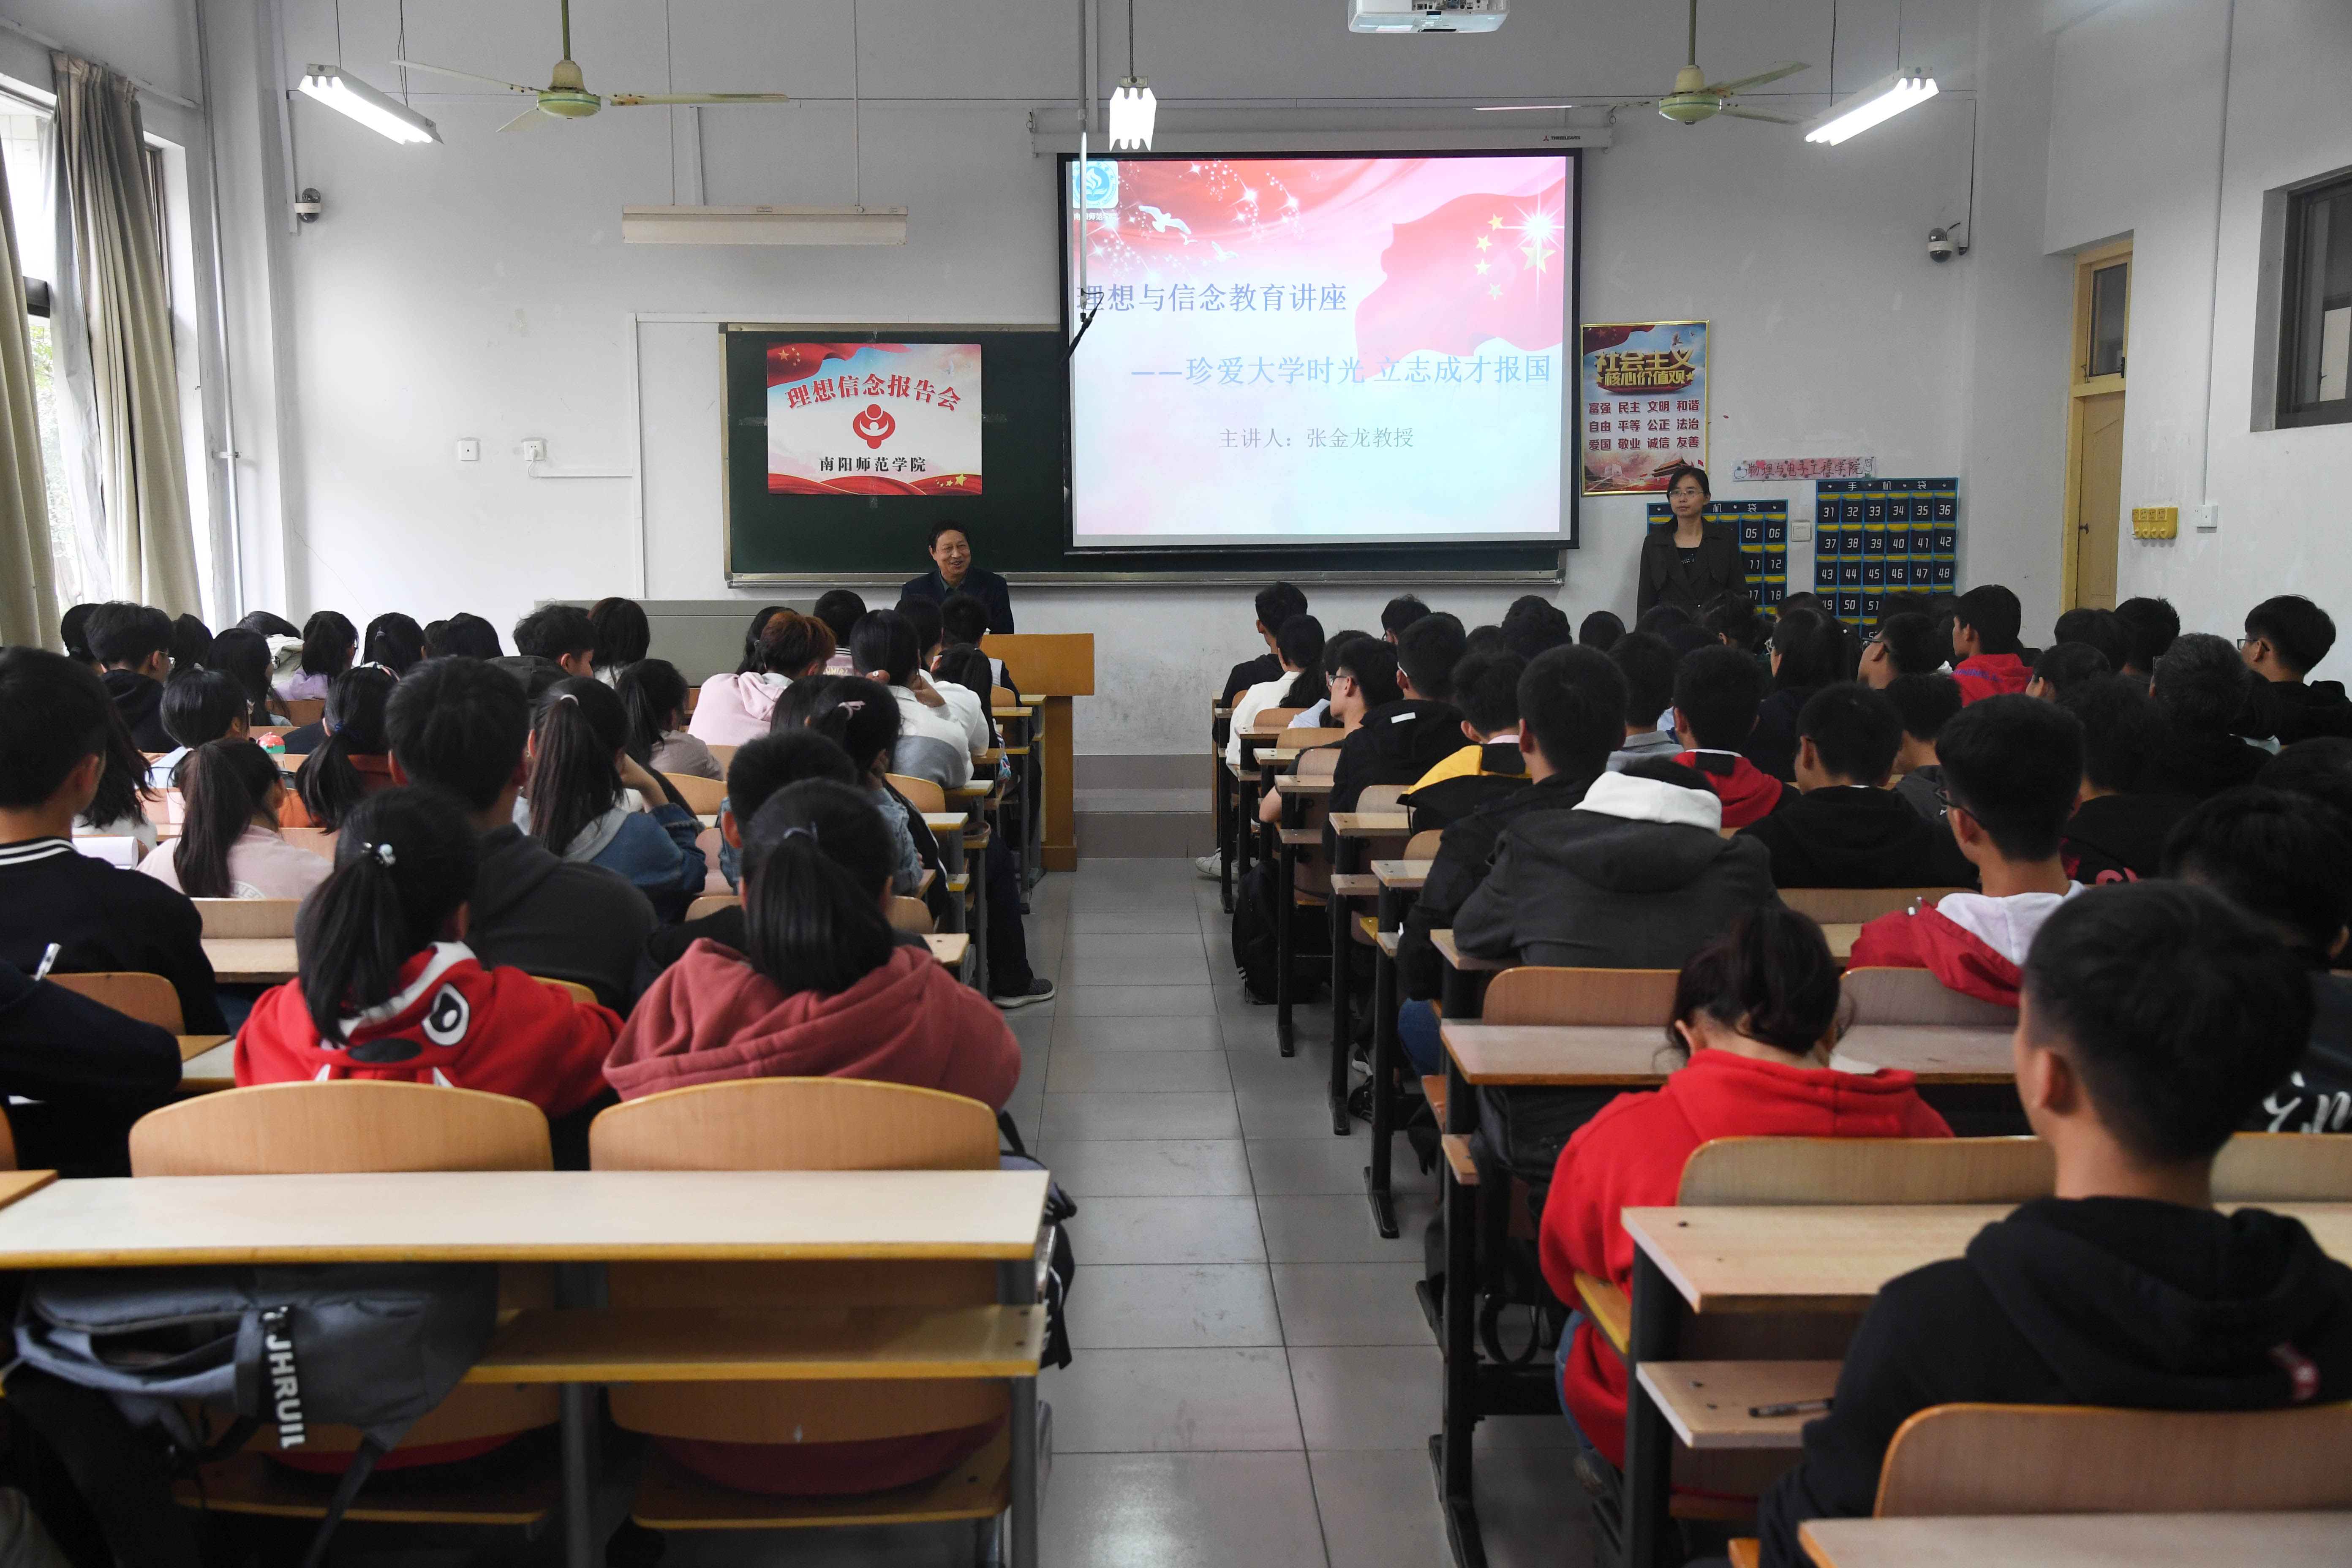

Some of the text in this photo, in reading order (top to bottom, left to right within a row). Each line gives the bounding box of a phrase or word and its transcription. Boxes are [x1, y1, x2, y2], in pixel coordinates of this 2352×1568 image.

[1076, 284, 1347, 312] 理想与信念教育讲座
[1594, 348, 1695, 372] 社会主义
[1374, 355, 1551, 384] 立志成才报国
[1604, 370, 1685, 386] 核心价值观
[785, 373, 961, 411] 理想信念报告会
[1589, 400, 1699, 414] 富强 民主 文明 和谐
[1589, 418, 1699, 432] 自由 平等 公正 法治
[1589, 436, 1699, 450] 爱国 敬业 诚信 友善
[819, 457, 926, 472] 南阳师范学院
[1748, 460, 1863, 477] 物理与电子工程学院
[1824, 504, 1951, 517] 31 32 33 34 35 36
[1745, 528, 1780, 538] 05 06
[1825, 536, 1951, 548] 37 38 39 40 41 42
[1750, 559, 1781, 569] 11 12
[1822, 568, 1950, 579] 43 44 45 46 47 48
[1749, 590, 1781, 600] 17 18
[1844, 599, 1856, 610] 50
[1868, 601, 1879, 610] 51
